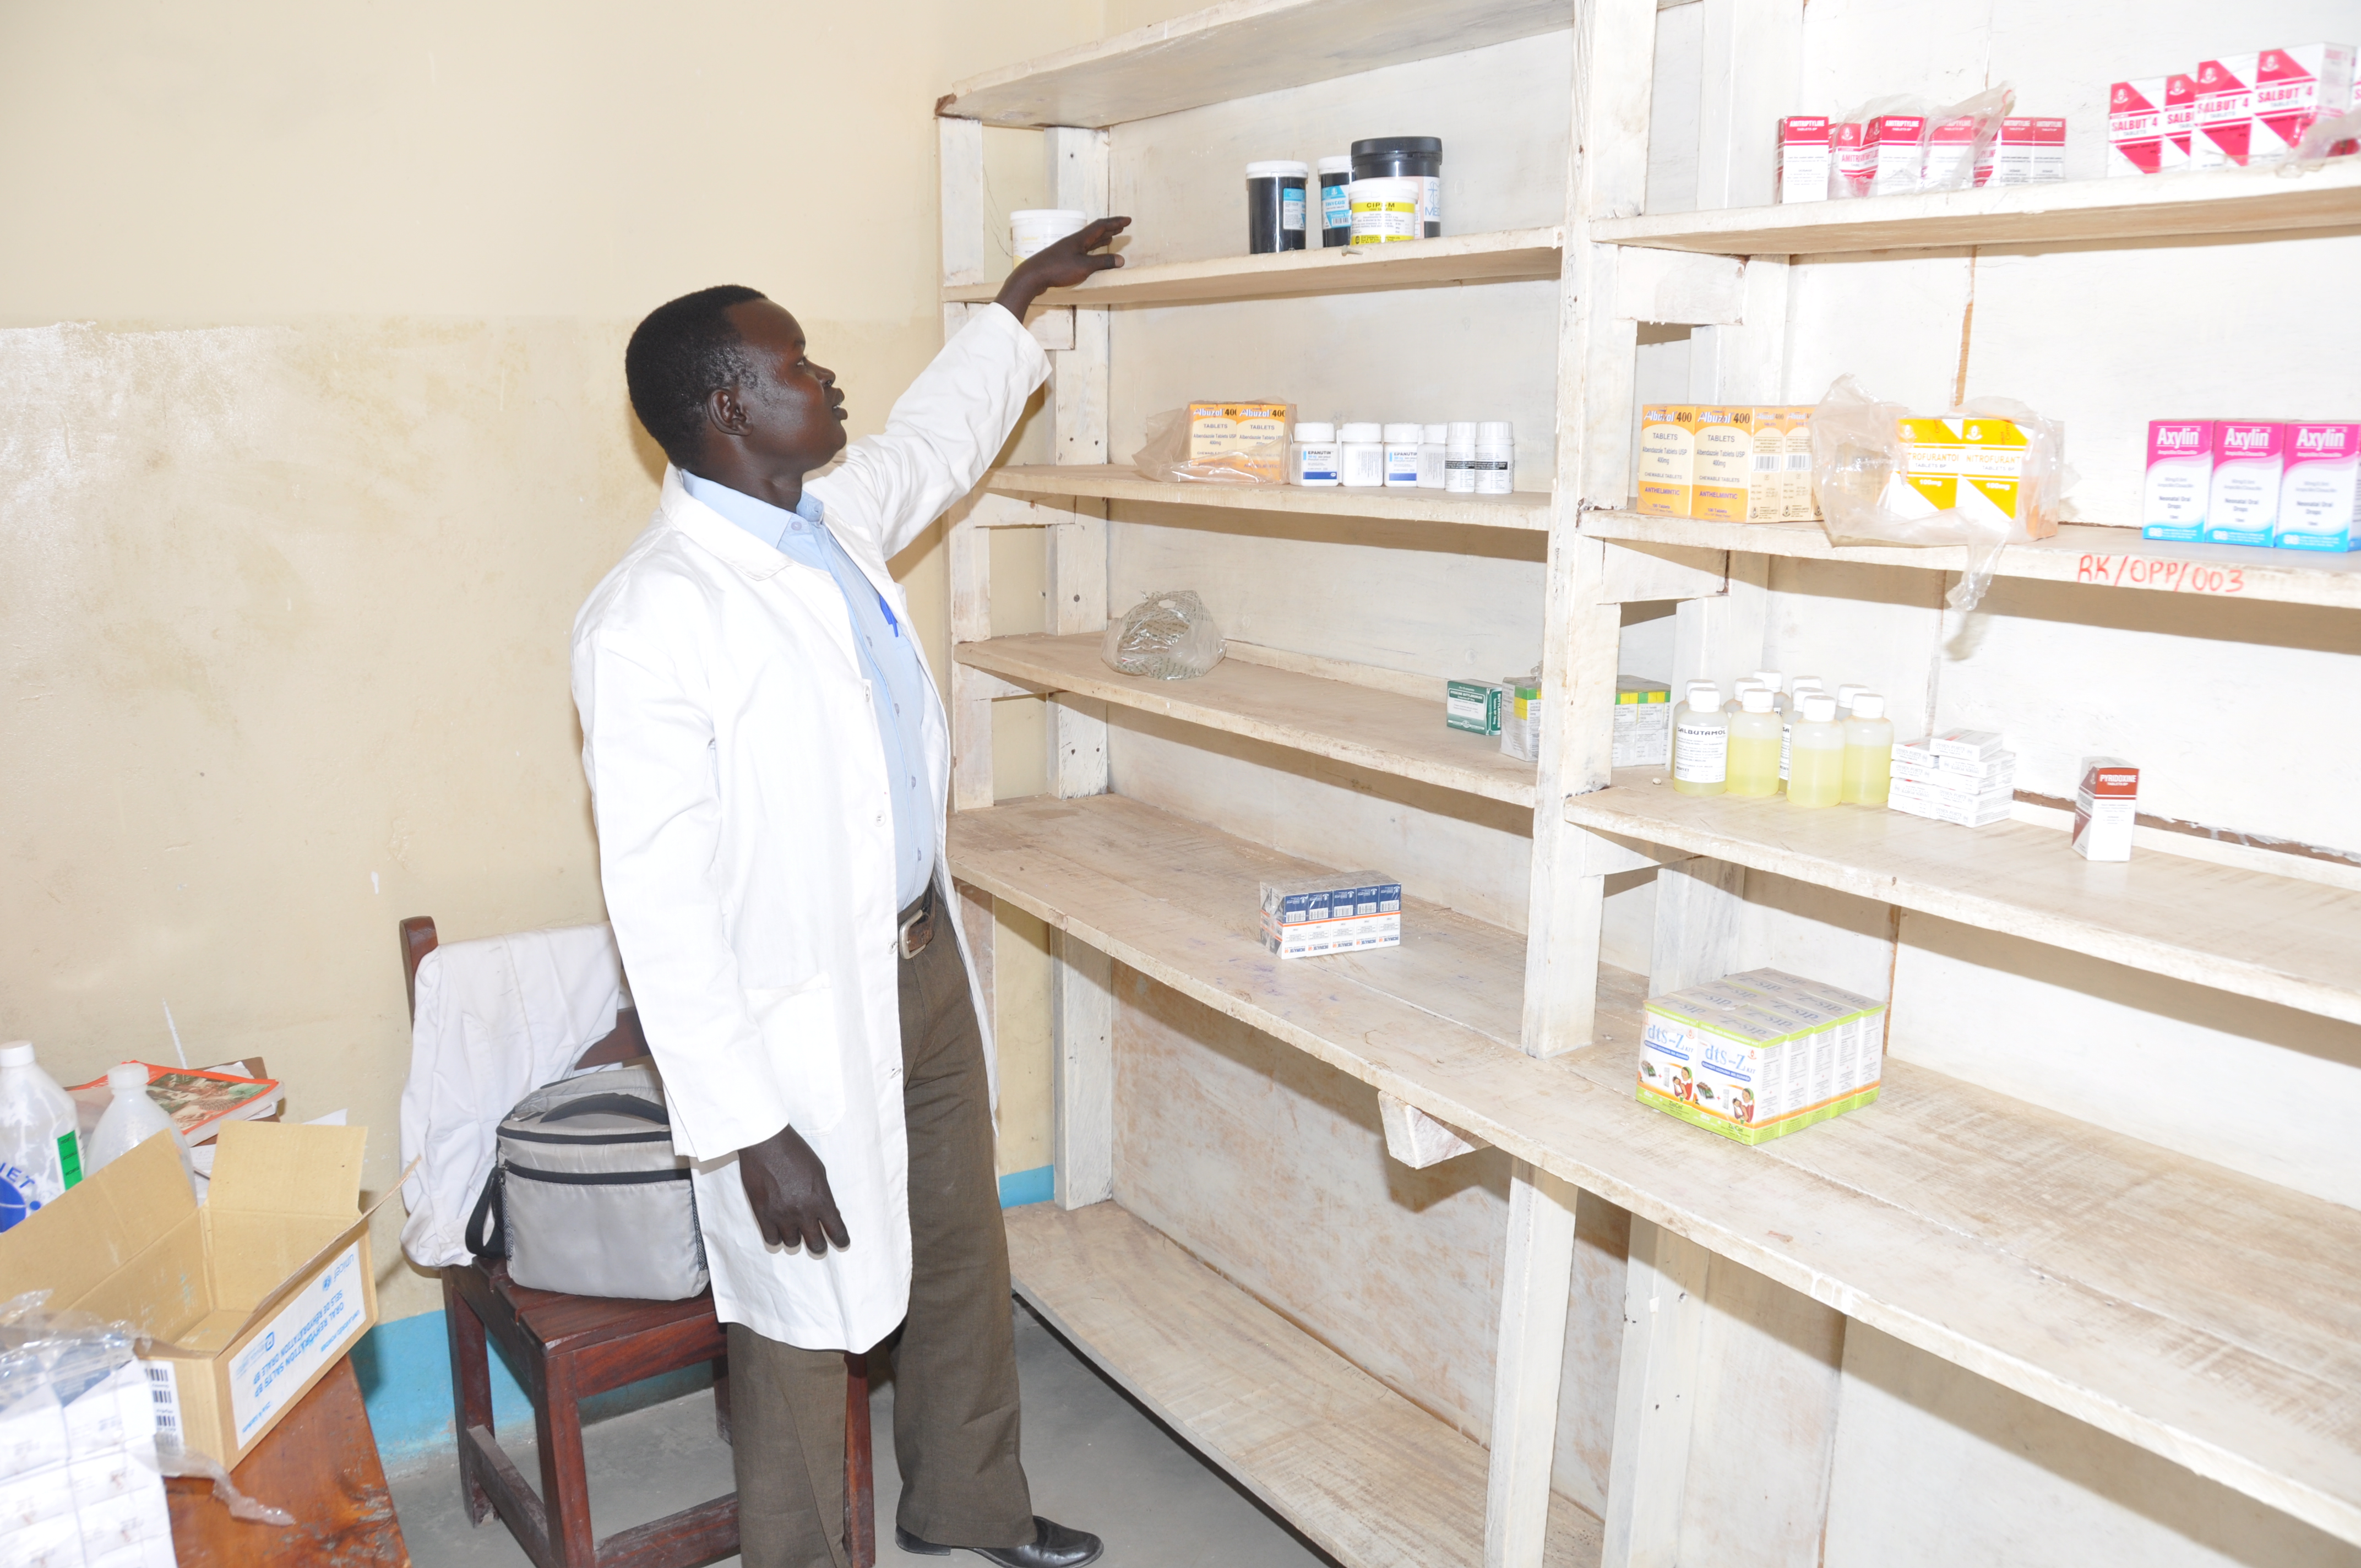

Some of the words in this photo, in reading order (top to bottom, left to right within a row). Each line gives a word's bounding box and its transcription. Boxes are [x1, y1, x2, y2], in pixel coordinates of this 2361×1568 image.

[2258, 87, 2300, 103] SALBUT
[2305, 85, 2313, 96] 4
[2197, 99, 2236, 113] SALBUT
[2242, 97, 2249, 107] 4
[2112, 118, 2146, 131] SALBUT
[2152, 117, 2158, 127] 4
[1193, 408, 1223, 416] Albuzol
[1239, 409, 1270, 417] Albuzol
[1644, 410, 1675, 422] Albuzol
[1677, 412, 1692, 422] 400
[1697, 412, 1732, 423] Albuzol
[1733, 413, 1750, 423] 400
[2157, 427, 2199, 449] Axylin
[2224, 428, 2269, 450] Axylin
[2297, 428, 2345, 451] Axylin
[1908, 453, 1959, 461] TROFURANTOI
[1966, 454, 2021, 464] NITROFURANT
[1645, 487, 1680, 495] ANTHELMINTIC
[1699, 491, 1738, 499] ANTHELMINTIC
[1677, 727, 1726, 736] SALBUTAMOL
[1647, 1024, 1684, 1050] dts-Z
[1705, 1045, 1745, 1071] dts-Z
[334, 1254, 354, 1282] unicef
[331, 1289, 342, 1308] SELS
[323, 1302, 330, 1314] DE
[329, 1302, 344, 1320] ORAL
[285, 1319, 328, 1366] REHYDRATION
[262, 1353, 279, 1376] ORALE
[253, 1371, 260, 1384] BP
[264, 1362, 284, 1388] SALTS
[254, 1383, 263, 1397] BP
